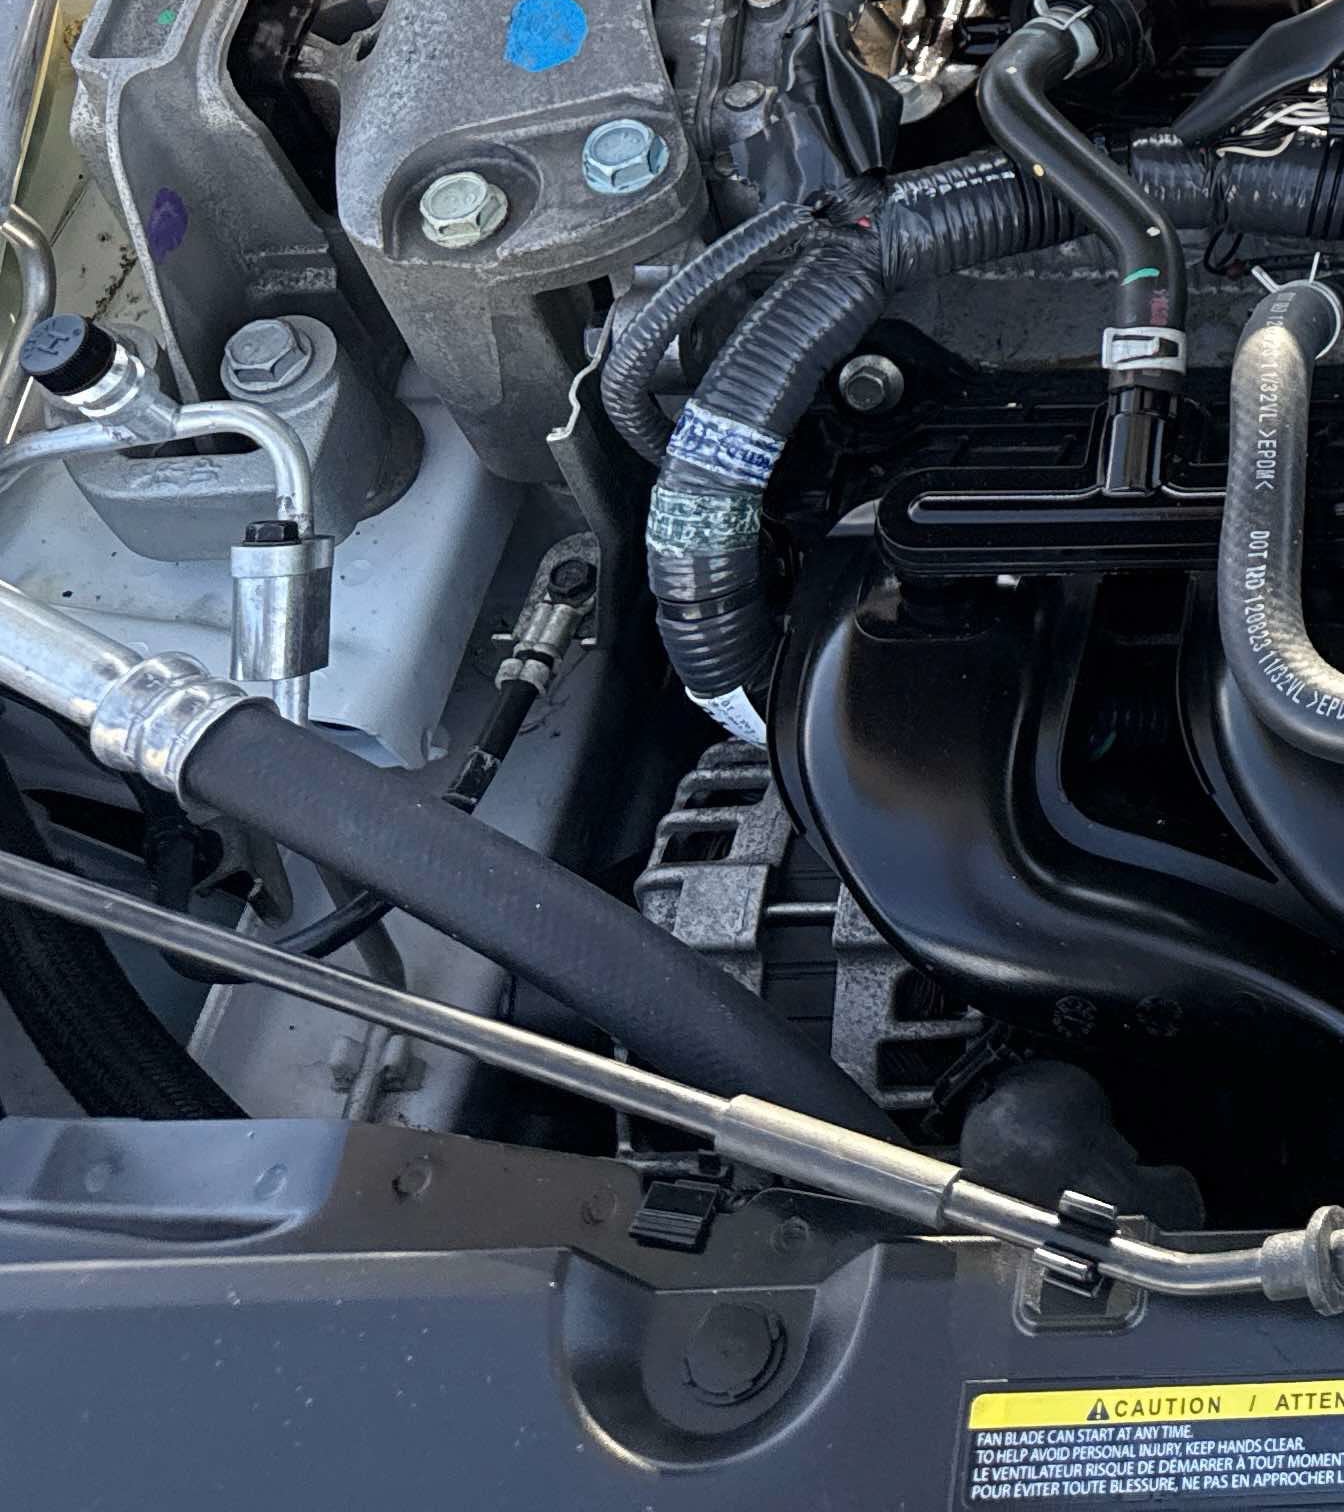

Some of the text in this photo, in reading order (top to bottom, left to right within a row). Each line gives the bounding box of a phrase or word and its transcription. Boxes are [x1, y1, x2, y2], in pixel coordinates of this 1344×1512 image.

[1259, 361, 1278, 423] 11/32VL
[1248, 530, 1270, 560] DOT
[1245, 593, 1265, 654] 120823
[1258, 648, 1301, 705] 11/32VL
[1114, 1397, 1221, 1418] CAUTION
[977, 1425, 1193, 1447] FAN BLADE CAN START AT ANY TIME.
[978, 1450, 995, 1464] TO
[997, 1448, 1027, 1463] HELP
[1030, 1447, 1069, 1462] AVOID
[1072, 1444, 1136, 1460] PERSONAL
[1139, 1442, 1183, 1458] INJURY,
[1186, 1441, 1215, 1455] KEEP
[1218, 1439, 1262, 1454] HANDS
[973, 1468, 991, 1482] LE
[992, 1464, 1084, 1481] VENTILATEUR
[1086, 1460, 1135, 1478] RISQUE
[1137, 1460, 1155, 1475] DE
[1236, 1454, 1246, 1471] À
[1250, 1454, 1283, 1469] TOUT
[971, 1485, 1011, 1500] POUR
[1014, 1480, 1060, 1498] ÉVITER
[1063, 1479, 1107, 1495] TOUTE
[1110, 1477, 1178, 1493] BLESSURE,
[1182, 1475, 1201, 1490] NE
[1204, 1474, 1228, 1489] PAS
[1232, 1473, 1250, 1488] EN
[1254, 1470, 1335, 1487] APPROCHER
